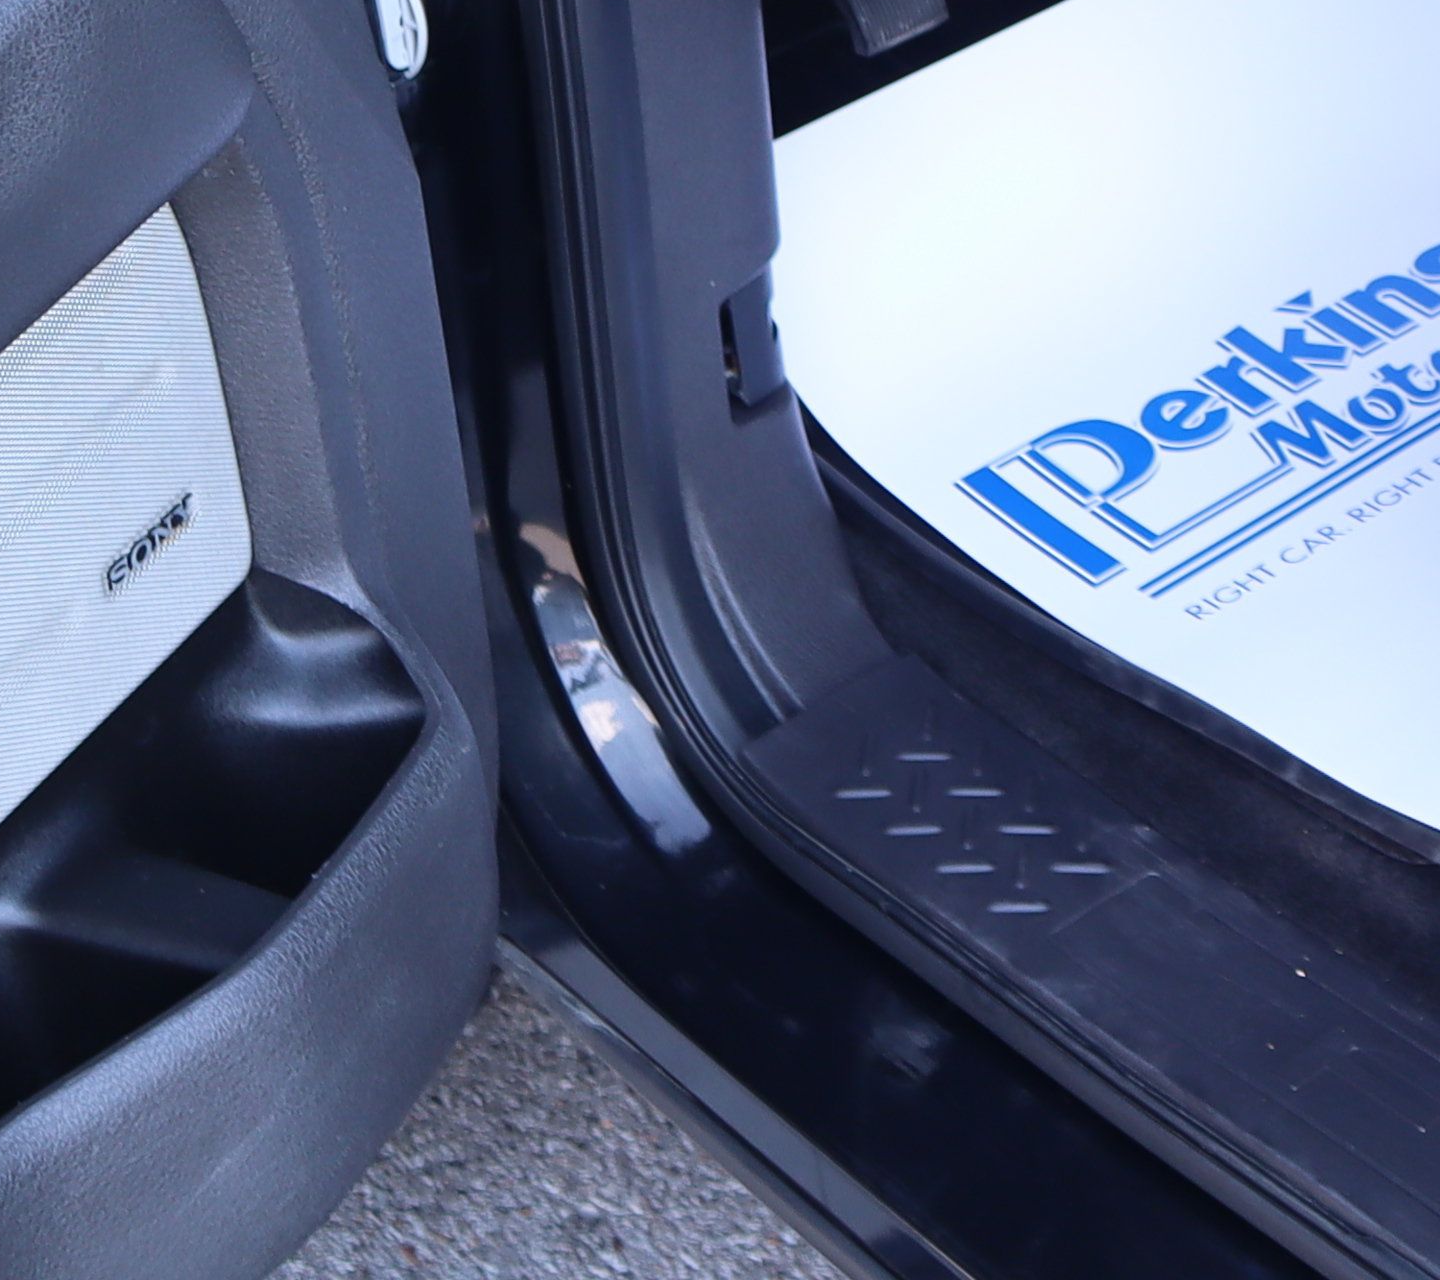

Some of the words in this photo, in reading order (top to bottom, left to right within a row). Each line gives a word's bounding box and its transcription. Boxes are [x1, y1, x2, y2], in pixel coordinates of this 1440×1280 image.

[106, 491, 196, 593] SONY
[1183, 562, 1276, 621] RIGHT
[1279, 524, 1354, 565] CAR.
[1346, 468, 1435, 523] RIGHT
